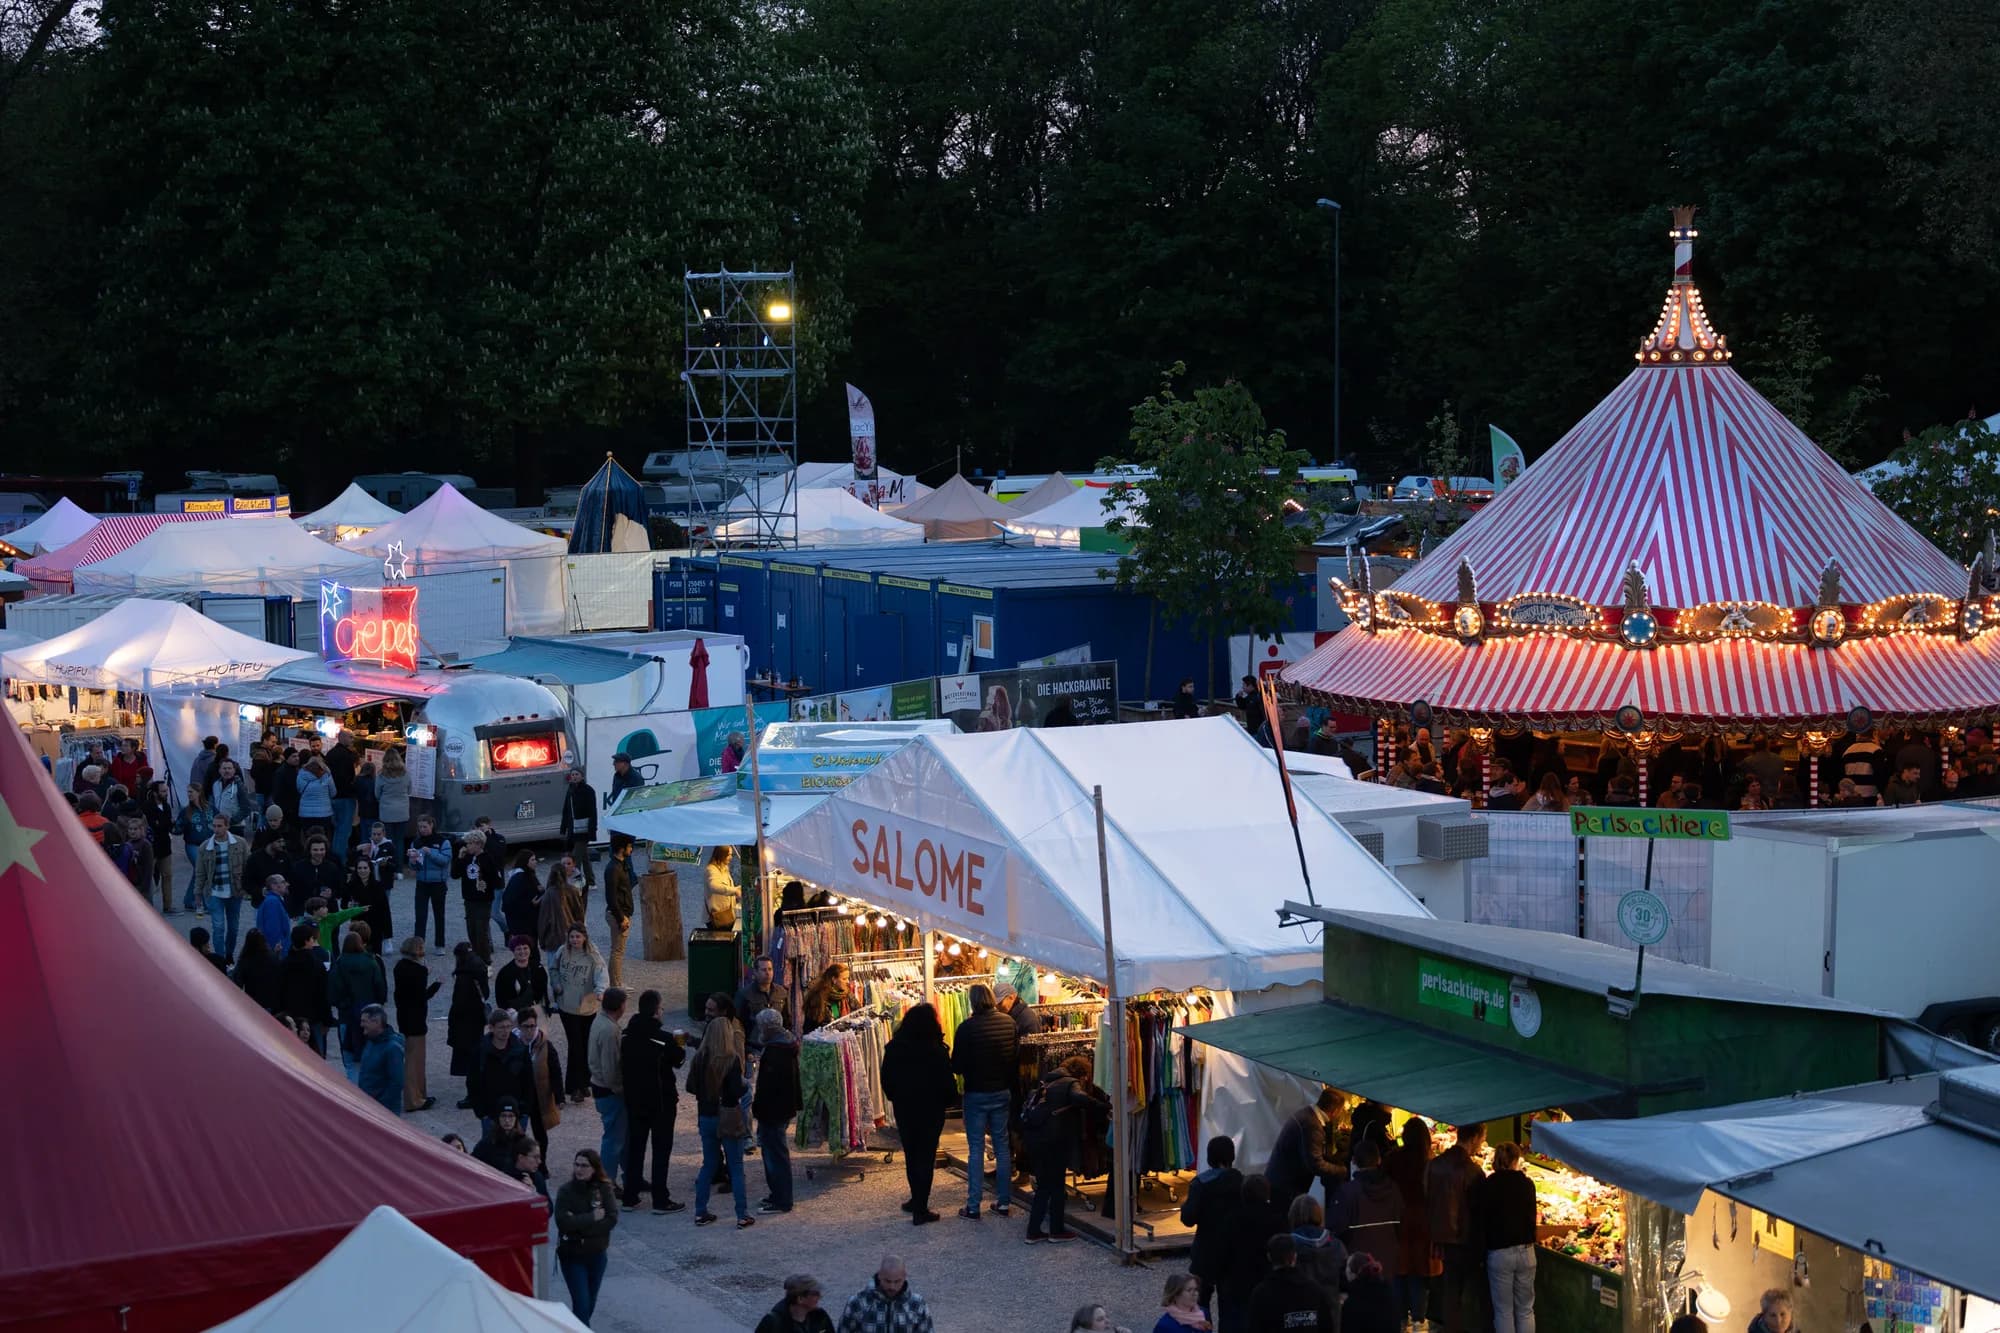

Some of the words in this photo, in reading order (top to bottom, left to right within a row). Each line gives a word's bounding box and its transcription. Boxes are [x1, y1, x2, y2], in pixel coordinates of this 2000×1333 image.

[1037, 683, 1051, 697] DIE
[1052, 677, 1111, 695] HACKGRANATE
[1574, 812, 1725, 838] Perlsacktiere
[664, 847, 695, 860] Salate
[852, 819, 985, 916] SALOME
[1635, 907, 1651, 922] 30
[1422, 972, 1505, 1009] perlsacktiere.de
